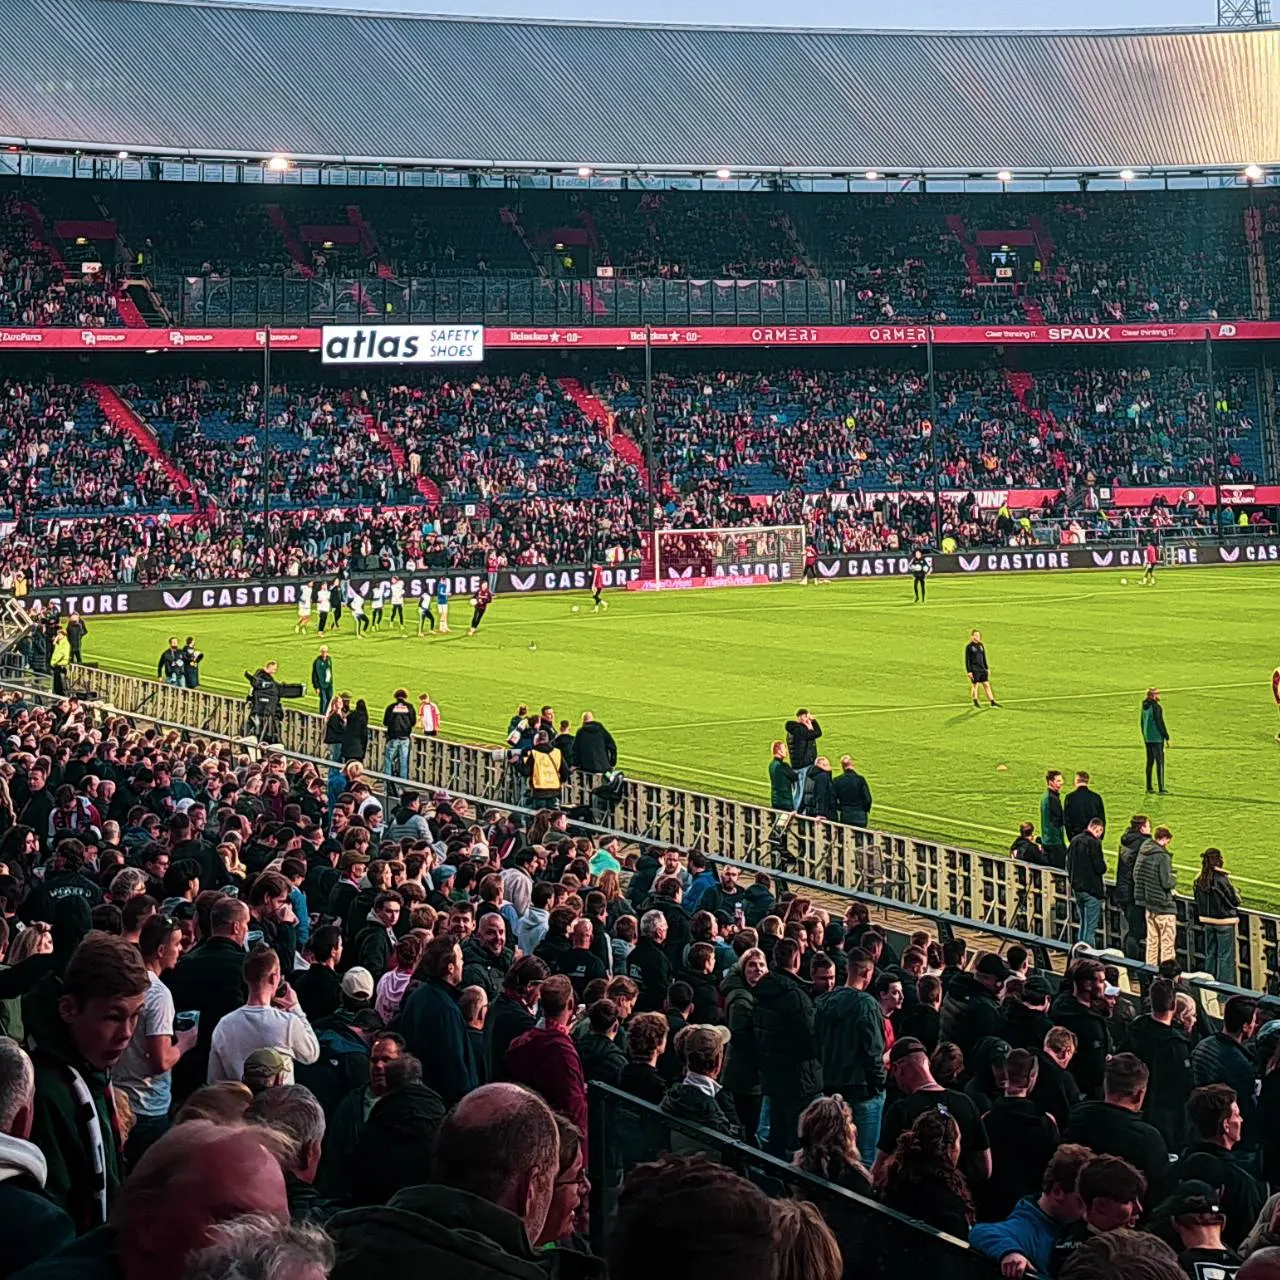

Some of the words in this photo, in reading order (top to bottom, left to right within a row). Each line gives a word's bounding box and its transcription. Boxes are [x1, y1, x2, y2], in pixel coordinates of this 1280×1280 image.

[184, 334, 213, 342] GROUP
[430, 329, 480, 342] SAFETY
[1048, 328, 1110, 340] SPAUX
[326, 330, 419, 358] atlas
[430, 345, 473, 357] SHOES
[987, 552, 1069, 570] CASTORE
